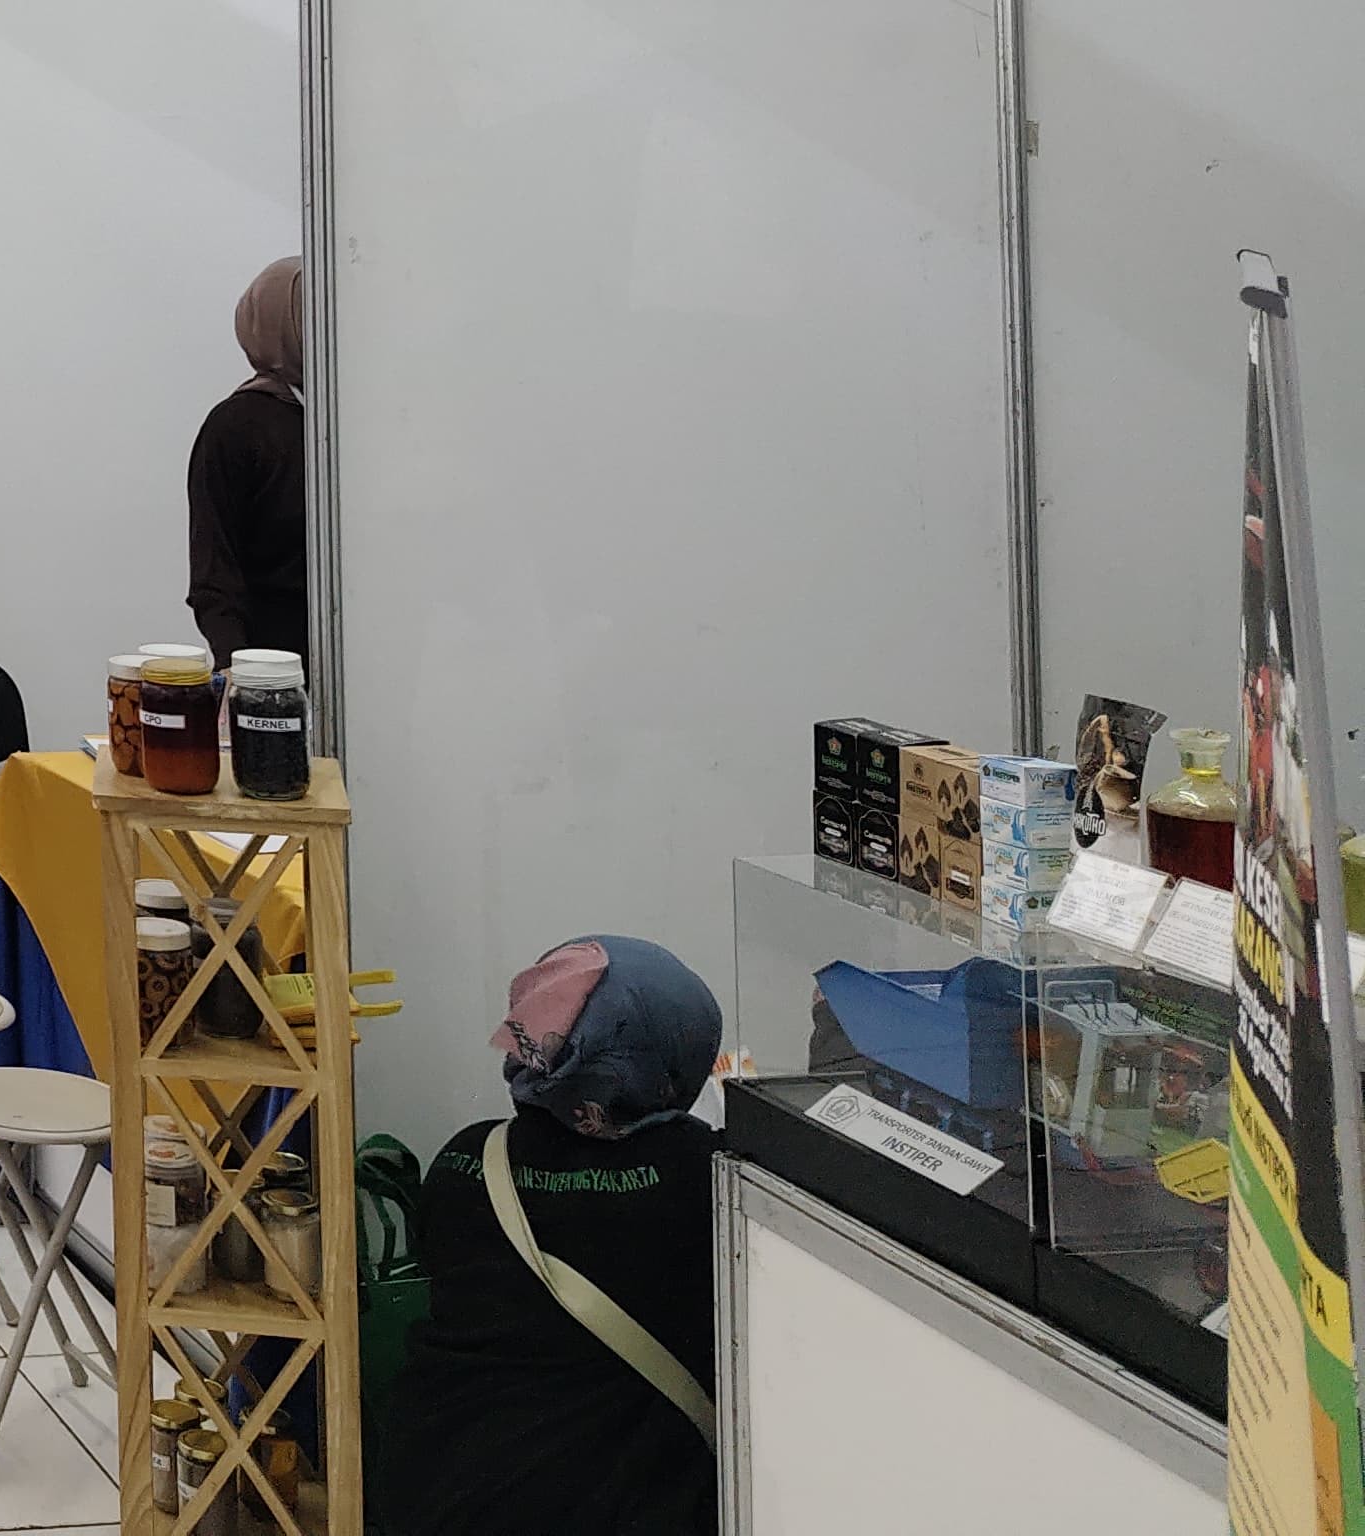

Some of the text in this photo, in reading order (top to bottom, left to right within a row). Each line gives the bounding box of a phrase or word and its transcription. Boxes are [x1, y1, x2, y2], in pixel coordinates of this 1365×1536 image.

[247, 718, 291, 730] KERNEL
[869, 1108, 926, 1142] TRANSPORTER
[925, 1136, 964, 1161] TANDAN
[881, 1135, 944, 1173] INSTIPER
